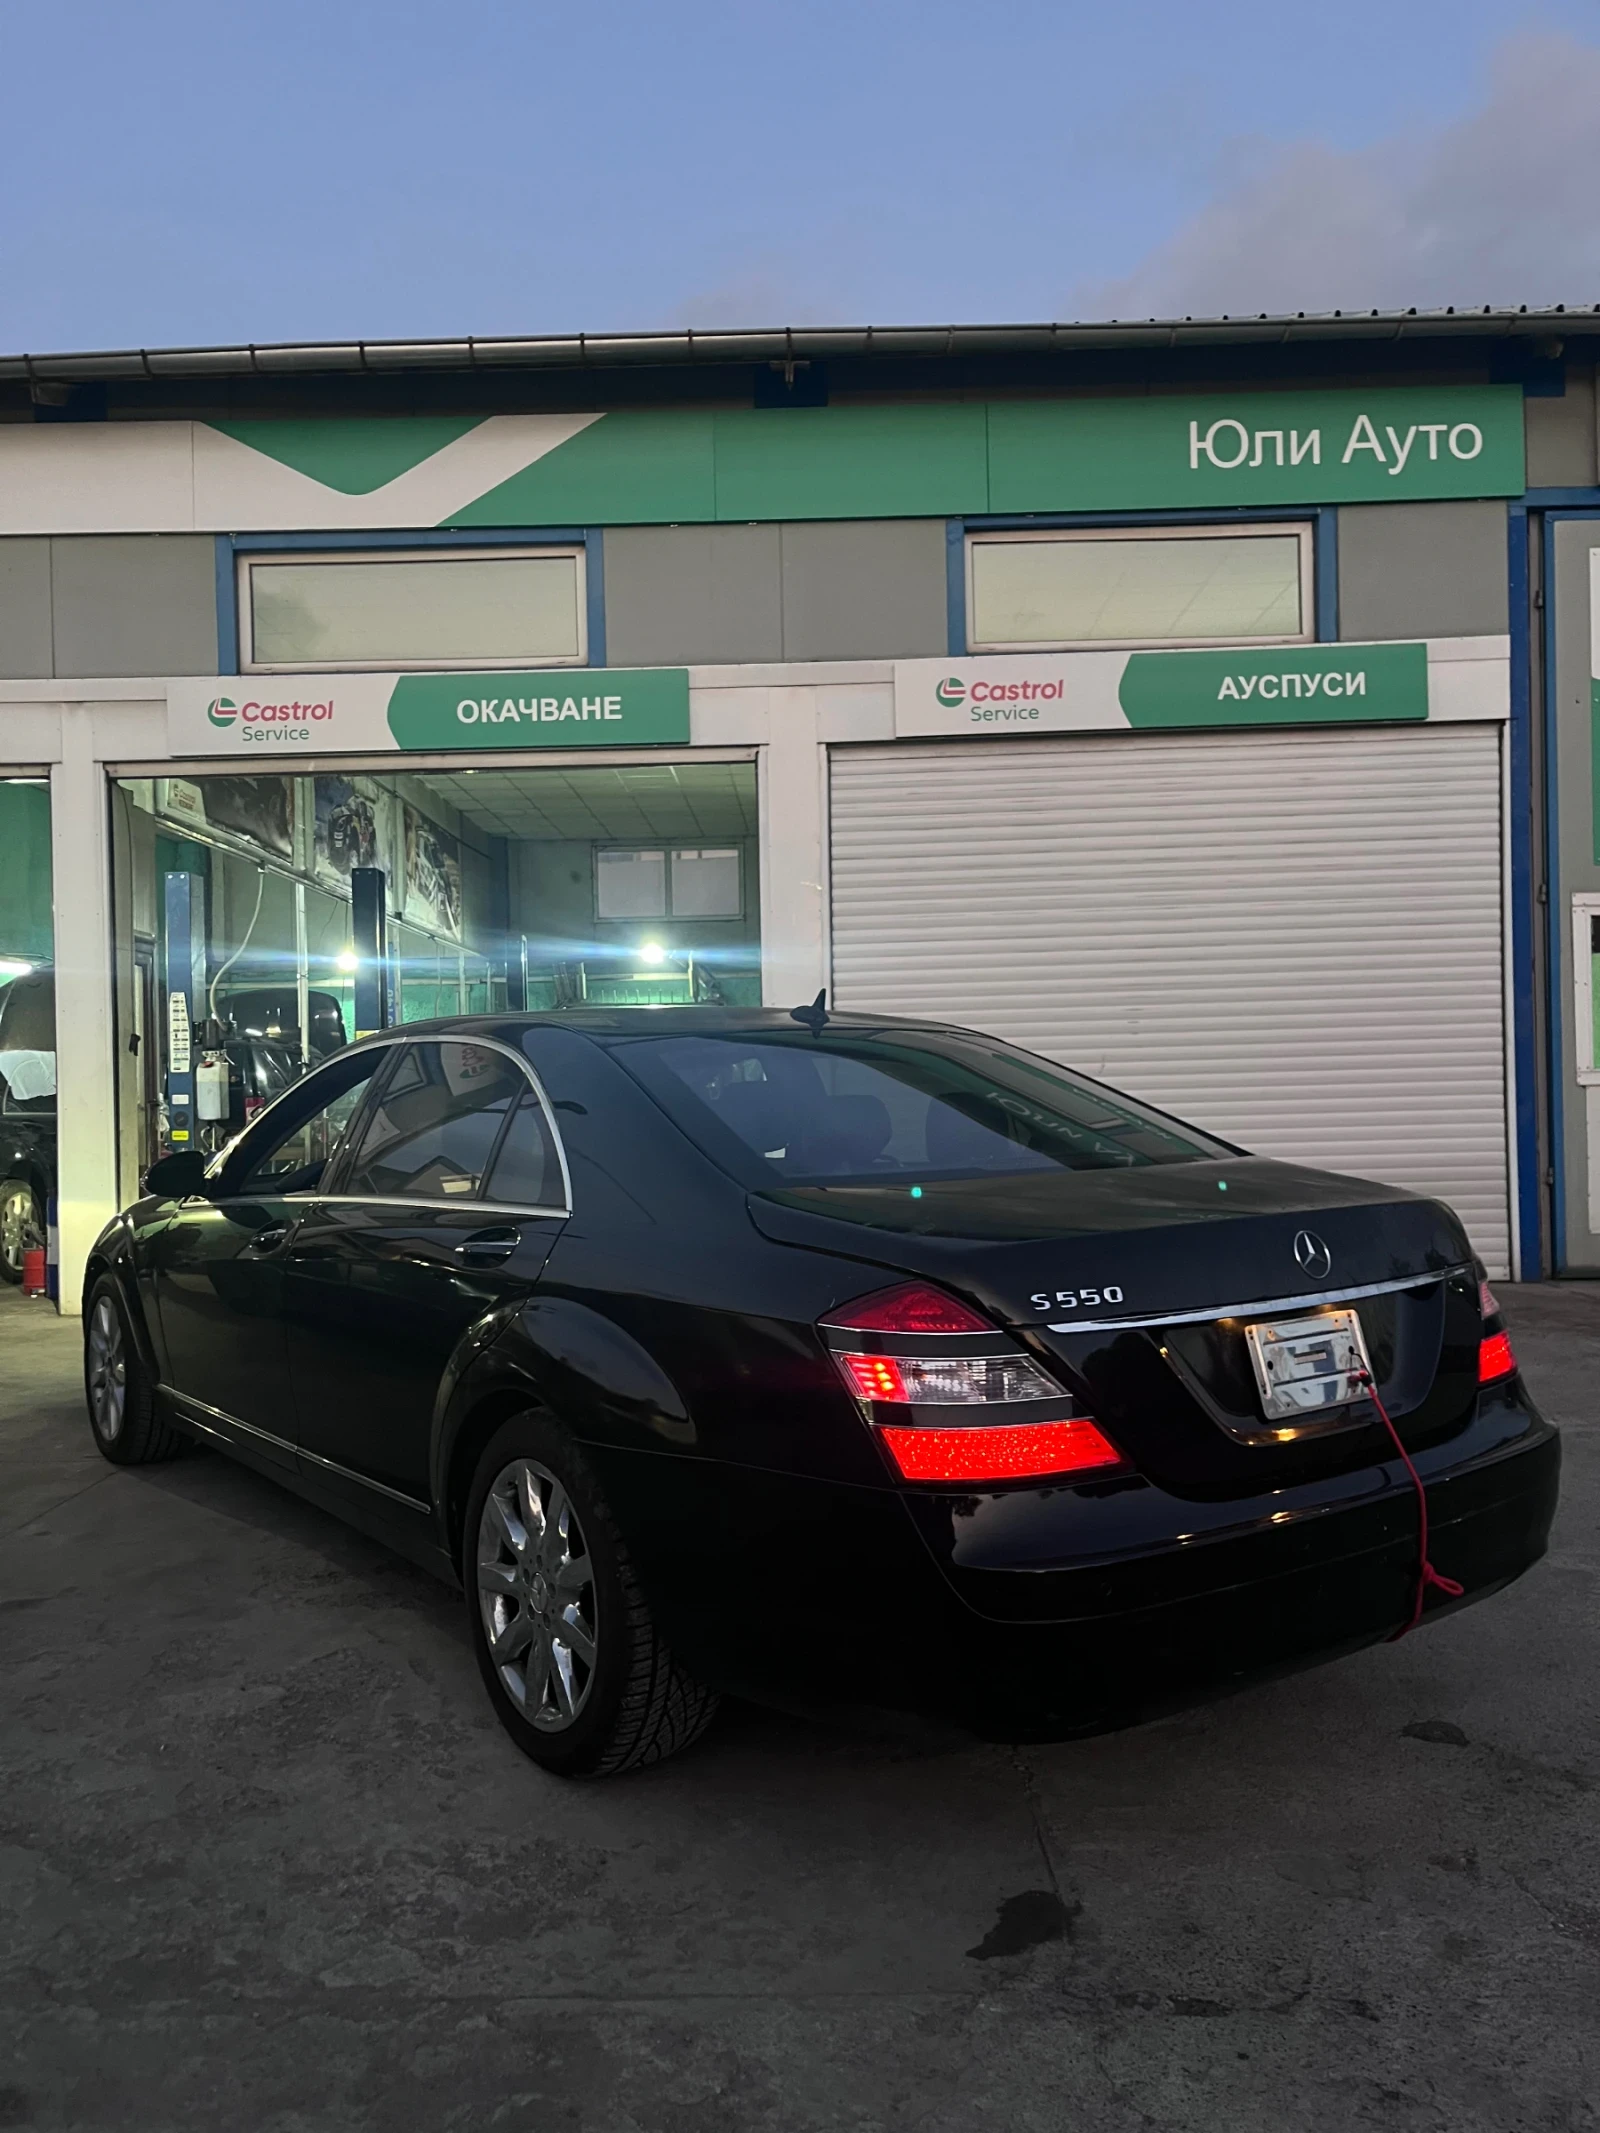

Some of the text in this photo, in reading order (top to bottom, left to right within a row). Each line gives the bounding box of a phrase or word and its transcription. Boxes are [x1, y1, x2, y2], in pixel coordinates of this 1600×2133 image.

[1189, 414, 1483, 477] Юли Ауто
[968, 678, 1064, 704] Castrol
[1217, 671, 1367, 701] АУСПУСИ
[240, 699, 334, 723] Castrol
[456, 695, 623, 724] ОКАЧВАНЕ
[970, 705, 1041, 722] Service
[242, 725, 310, 742] Service
